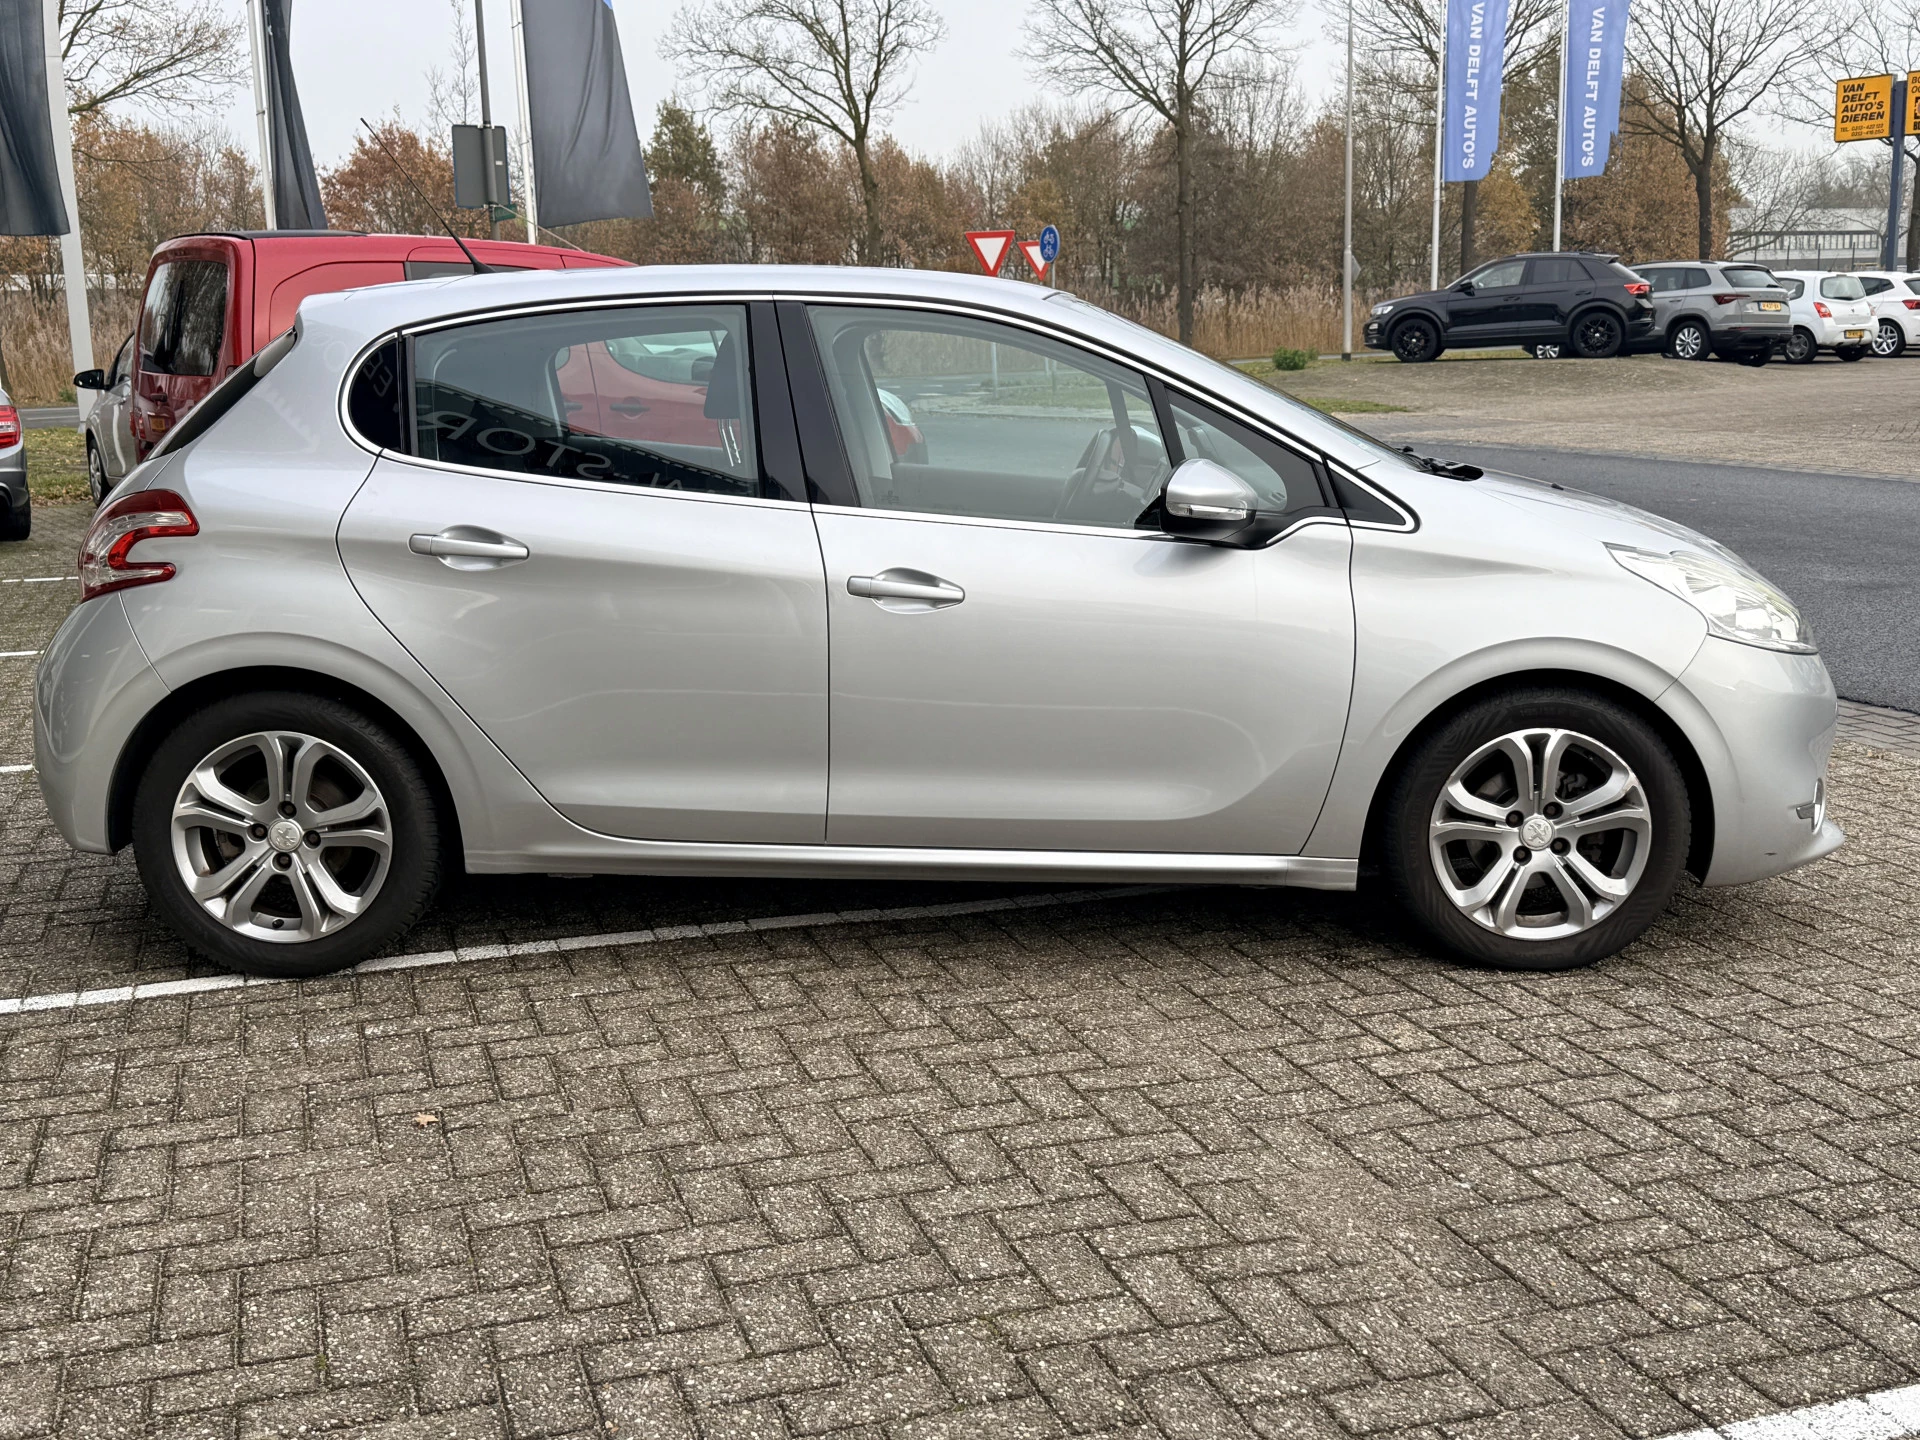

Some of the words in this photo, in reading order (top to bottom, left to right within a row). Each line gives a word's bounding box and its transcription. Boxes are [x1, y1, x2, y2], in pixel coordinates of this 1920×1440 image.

[1470, 2, 1486, 39] VAN
[1591, 6, 1606, 42] VAN
[1466, 45, 1481, 100] DELFT
[1585, 48, 1601, 101] DELFT
[1843, 83, 1865, 93] VAN
[1842, 91, 1880, 103] DELFT
[1842, 101, 1884, 113] AUTO'S
[1841, 111, 1885, 123] DIEREN
[1462, 104, 1477, 169] AUTO'S
[1581, 106, 1597, 167] AUTO'S
